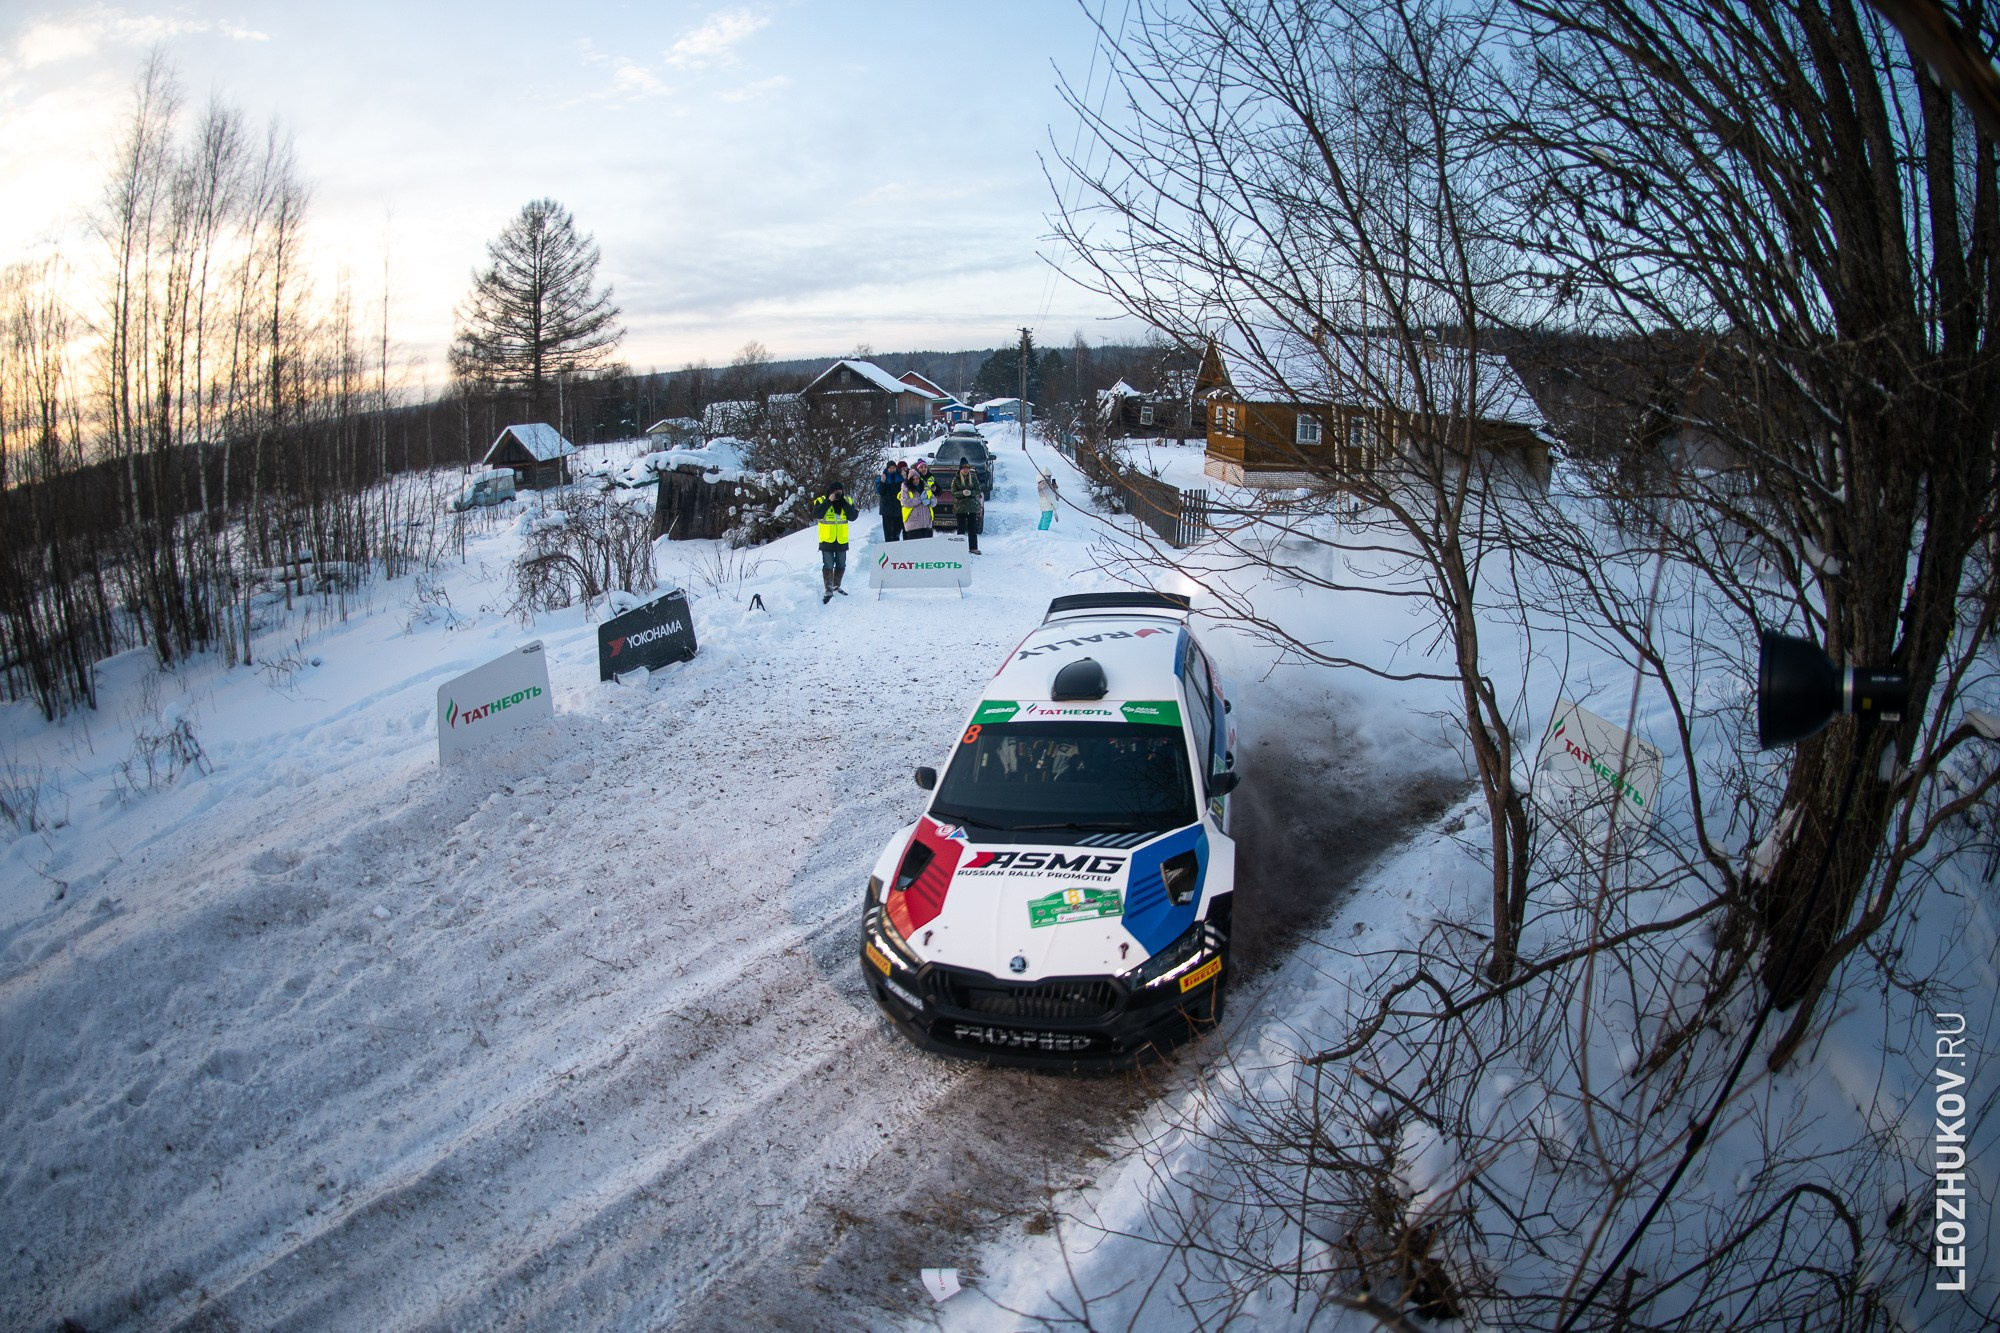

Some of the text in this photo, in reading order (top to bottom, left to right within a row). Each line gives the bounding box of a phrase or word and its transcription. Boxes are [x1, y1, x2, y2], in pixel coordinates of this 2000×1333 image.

[890, 560, 963, 570] ТАТНЕФТЬ
[627, 619, 683, 649] YOKOHAMA
[1018, 630, 1134, 661] RALLY
[461, 685, 543, 725] ТАТНЕФТЬ
[1038, 708, 1113, 716] ТАТНЕФТЬ
[962, 723, 983, 745] 8
[962, 851, 1127, 875] ASMG
[957, 869, 1112, 883] RUSSIAN RALLY PROMOTER
[1067, 888, 1080, 905] 8
[1183, 960, 1218, 988] PIRELLI
